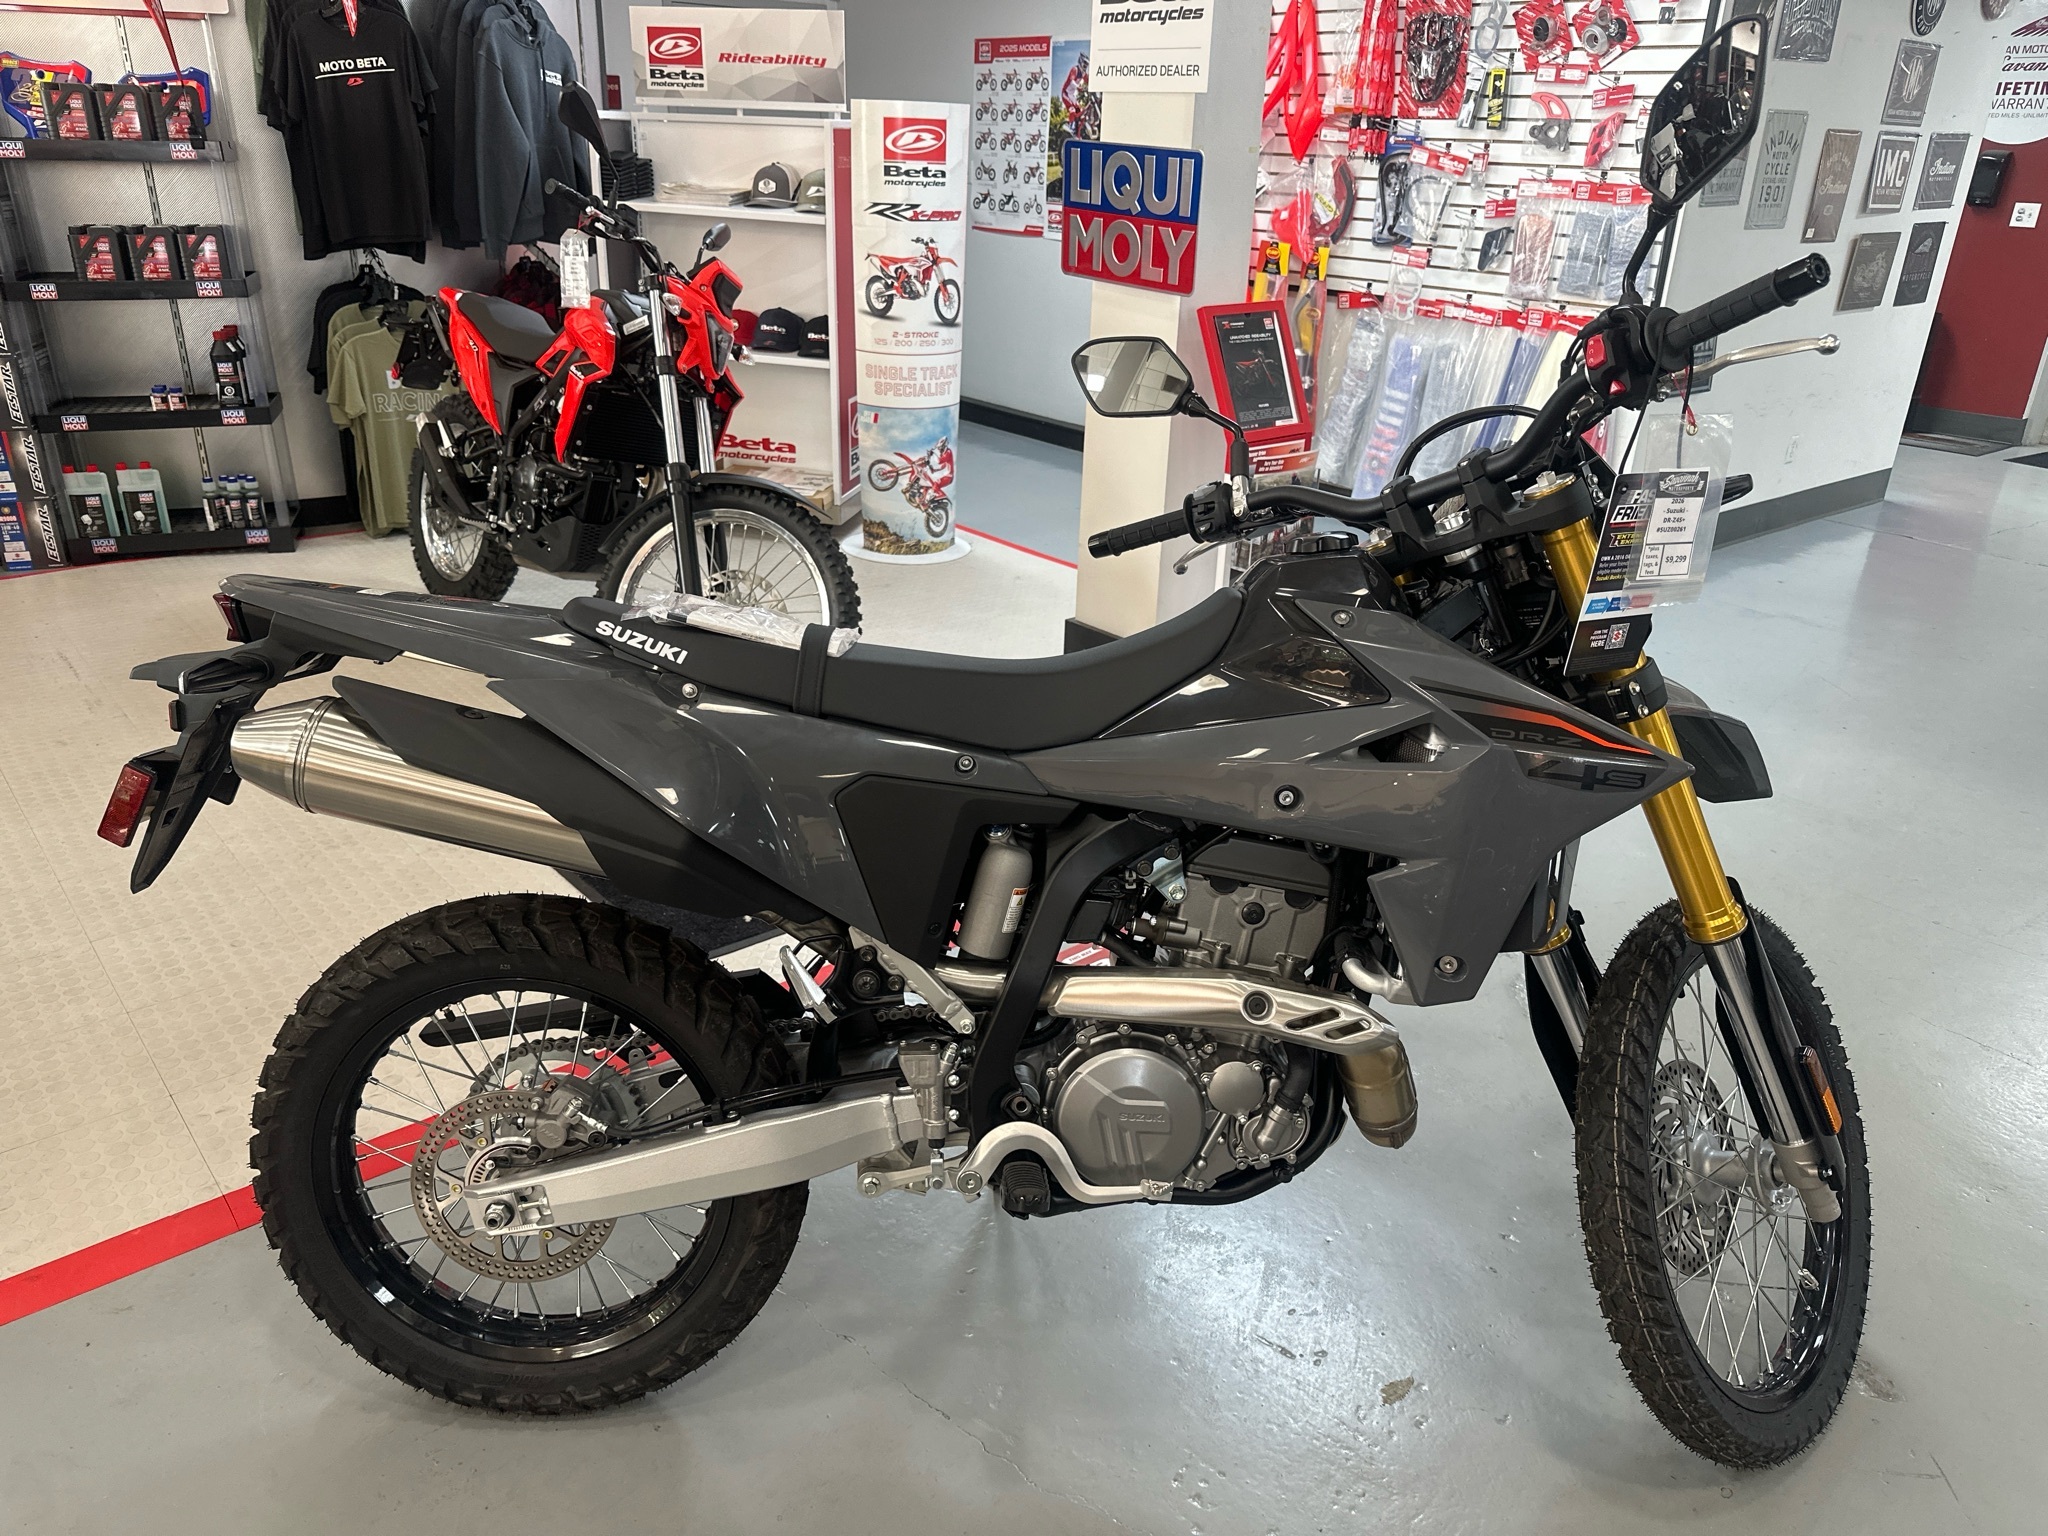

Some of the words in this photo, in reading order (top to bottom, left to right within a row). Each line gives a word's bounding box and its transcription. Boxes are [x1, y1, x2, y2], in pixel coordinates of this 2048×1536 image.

[1100, 6, 1204, 25] motorcycles
[1019, 43, 1048, 52] MODELS
[319, 59, 354, 73] MOTO
[357, 56, 387, 69] BETA
[718, 52, 827, 68] Rideability
[650, 68, 704, 81] Beta
[1096, 65, 1158, 77] AUTHORIZED
[1160, 64, 1200, 77] DEALER
[651, 80, 704, 89] motorcycles
[1765, 130, 1800, 155] INDIAN
[173, 151, 196, 159] MOLY
[1772, 151, 1789, 159] MOTOR
[883, 165, 946, 178] Beta
[1764, 162, 1791, 175] CYCLE
[1876, 149, 1911, 188] IMC
[1929, 157, 1956, 176] Indian
[884, 179, 946, 188] motorcycles
[1070, 147, 1195, 217] LIQUI
[1760, 185, 1786, 203] 1901
[1068, 213, 1195, 285] MOLY
[32, 284, 55, 292] LIQUI
[760, 324, 786, 332] Beta
[941, 338, 954, 346] 300
[865, 364, 917, 381] SINGLE
[920, 364, 958, 381] TRACK
[0, 361, 24, 425] ECSTAR
[874, 381, 952, 397] SPECIALIST
[62, 416, 87, 424] LIQUI
[22, 434, 46, 495] ECSTAR
[37, 504, 61, 562] ECSTAR
[1665, 555, 1687, 564] $9,299
[595, 620, 688, 665] SUZUKI
[1590, 639, 1605, 648] HERE
[1489, 727, 1582, 748] DR-Z
[1119, 1112, 1165, 1123] SUZUKI
